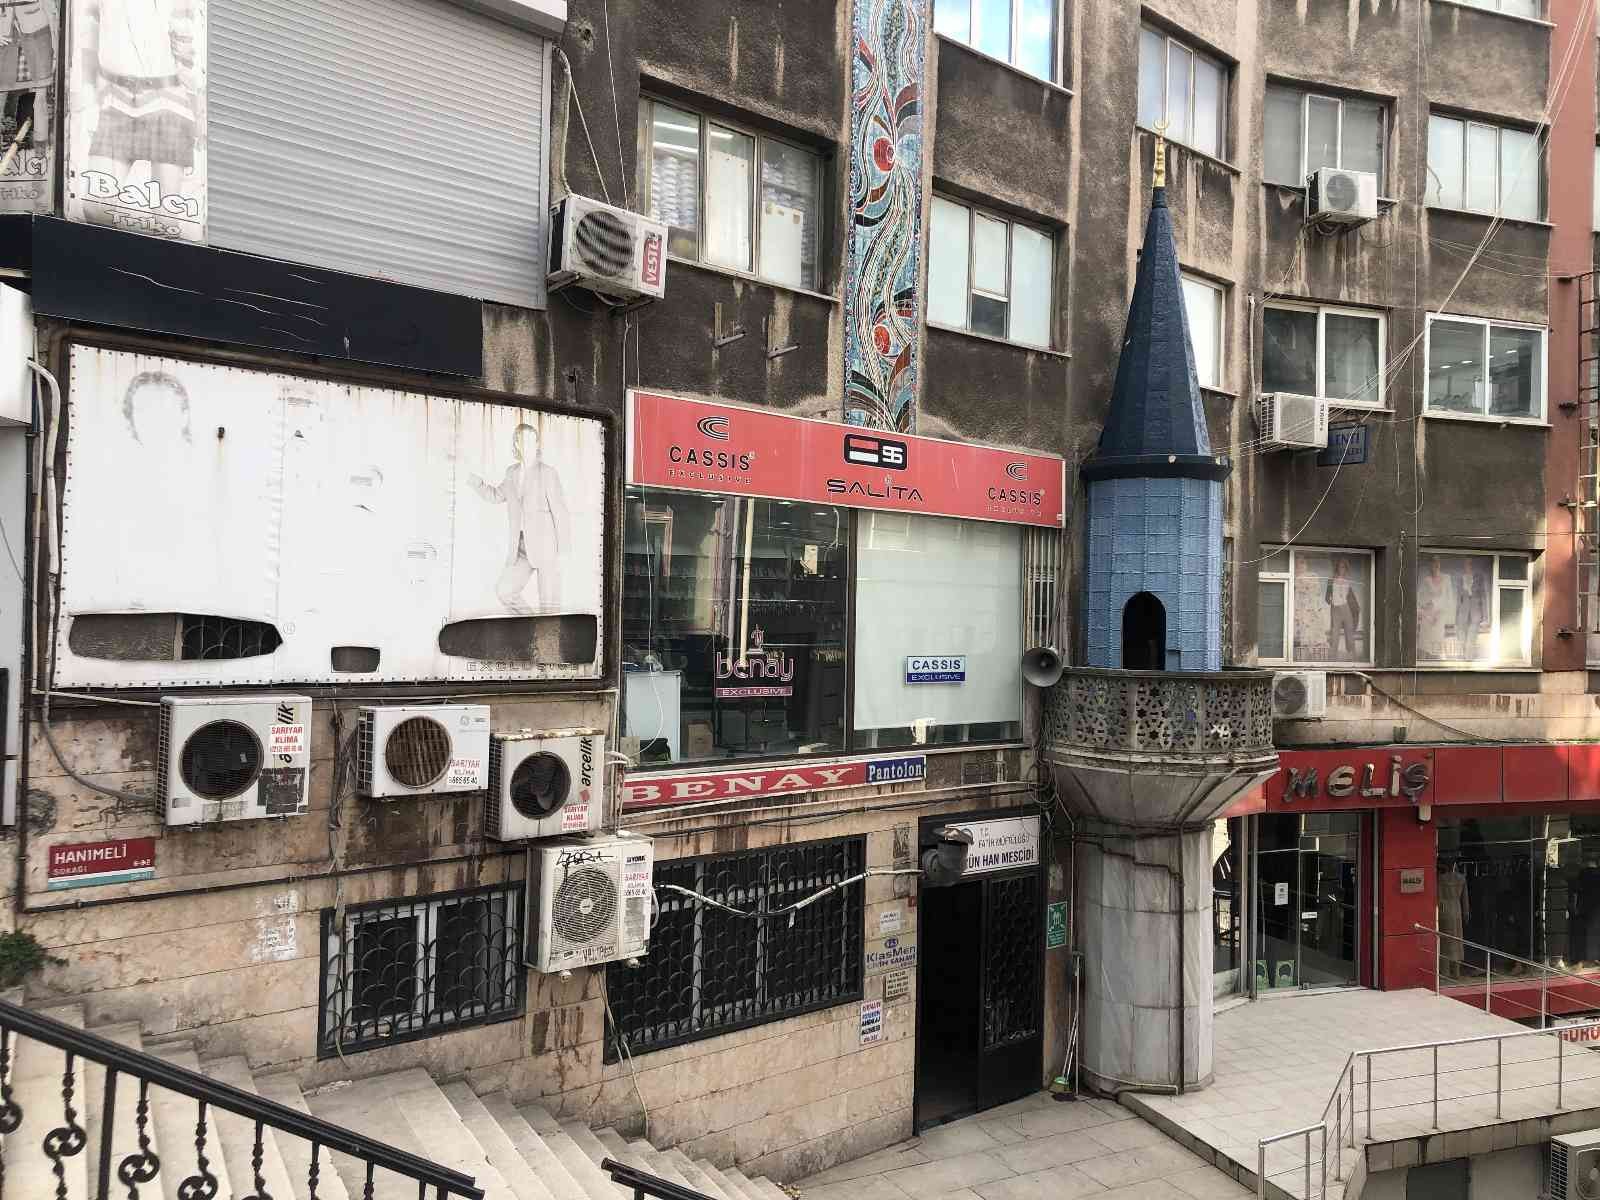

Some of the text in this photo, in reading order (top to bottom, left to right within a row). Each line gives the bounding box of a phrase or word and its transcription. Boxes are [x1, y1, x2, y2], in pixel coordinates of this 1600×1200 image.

[669, 446, 750, 471] CASSIS
[988, 487, 1041, 505] CASSIS
[716, 651, 794, 681] benay
[912, 659, 962, 671] CASSIS
[911, 673, 961, 681] EXCLUSIVE
[722, 688, 787, 696] EXCLUSIVE
[581, 736, 594, 787] arçelik
[868, 762, 923, 780] Pantolon
[622, 768, 852, 802] BENAY
[54, 844, 127, 865] HANIMELİ
[983, 853, 1000, 866] HAN
[1002, 846, 1034, 863] MESCİDİ
